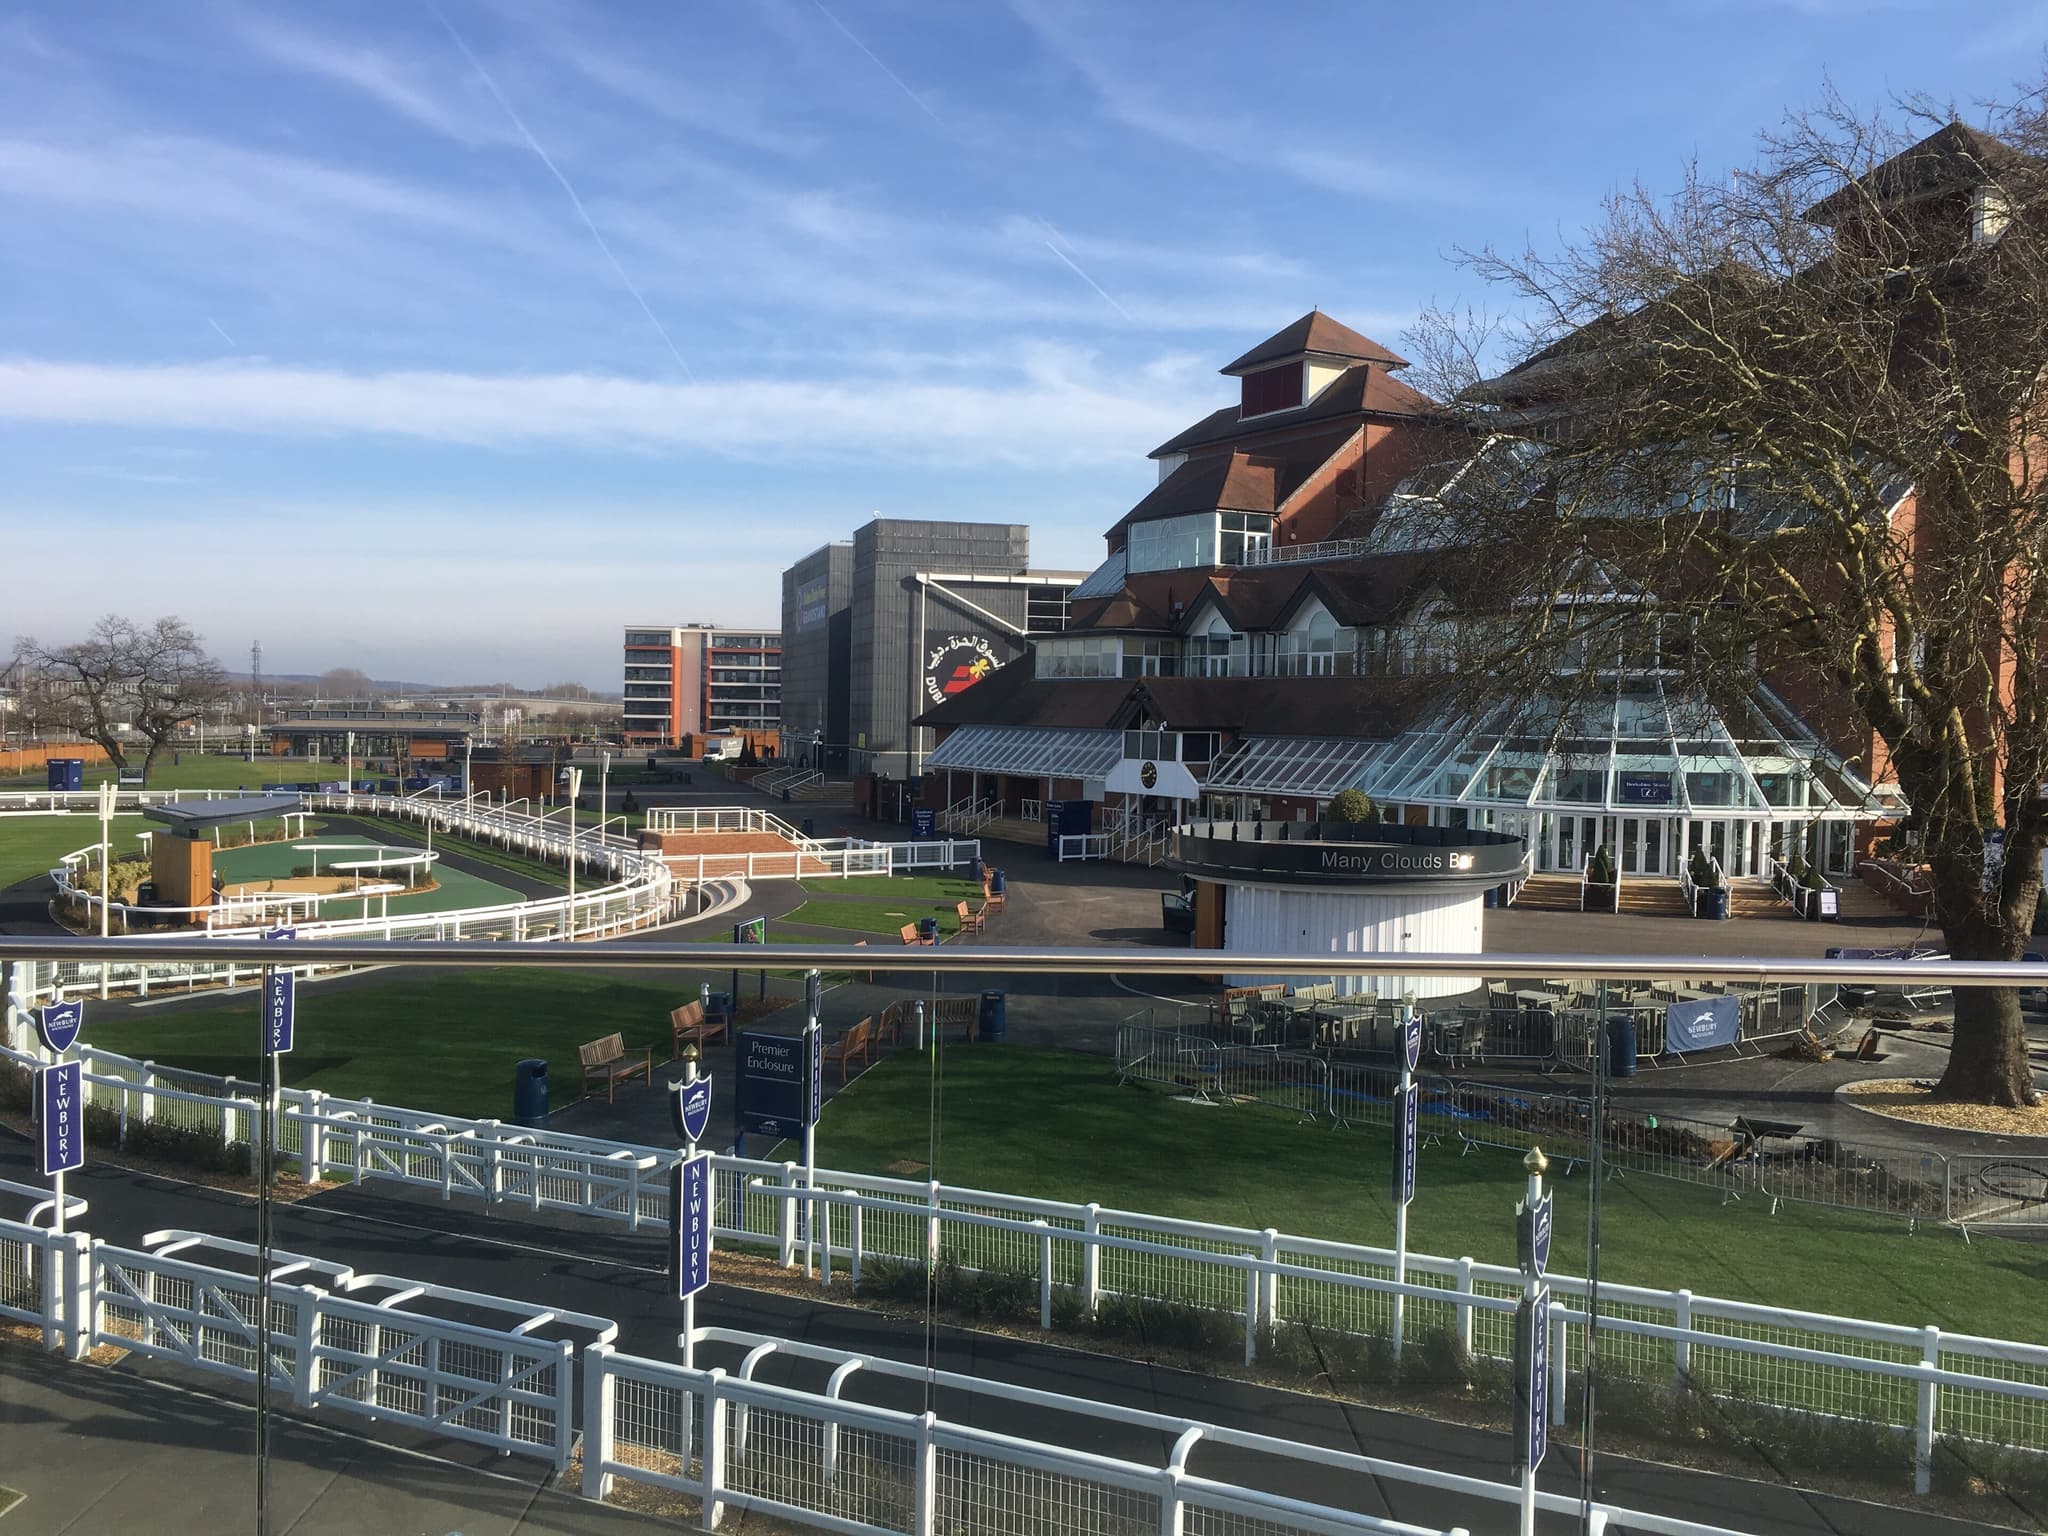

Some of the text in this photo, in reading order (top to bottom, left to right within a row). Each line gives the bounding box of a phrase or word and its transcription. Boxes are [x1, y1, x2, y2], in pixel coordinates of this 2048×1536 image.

[975, 638, 1006, 671] لسوق
[1321, 851, 1475, 872] Many Clouds Br
[272, 975, 286, 1049] NEWBURY
[1688, 1023, 1717, 1034] NEWBURY
[747, 1055, 794, 1073] Enclosure
[752, 1041, 790, 1057] Premier
[57, 1069, 69, 1165] NEWBURY
[690, 1163, 701, 1287] NEWBURY
[1535, 1302, 1544, 1456] NEWBURY
